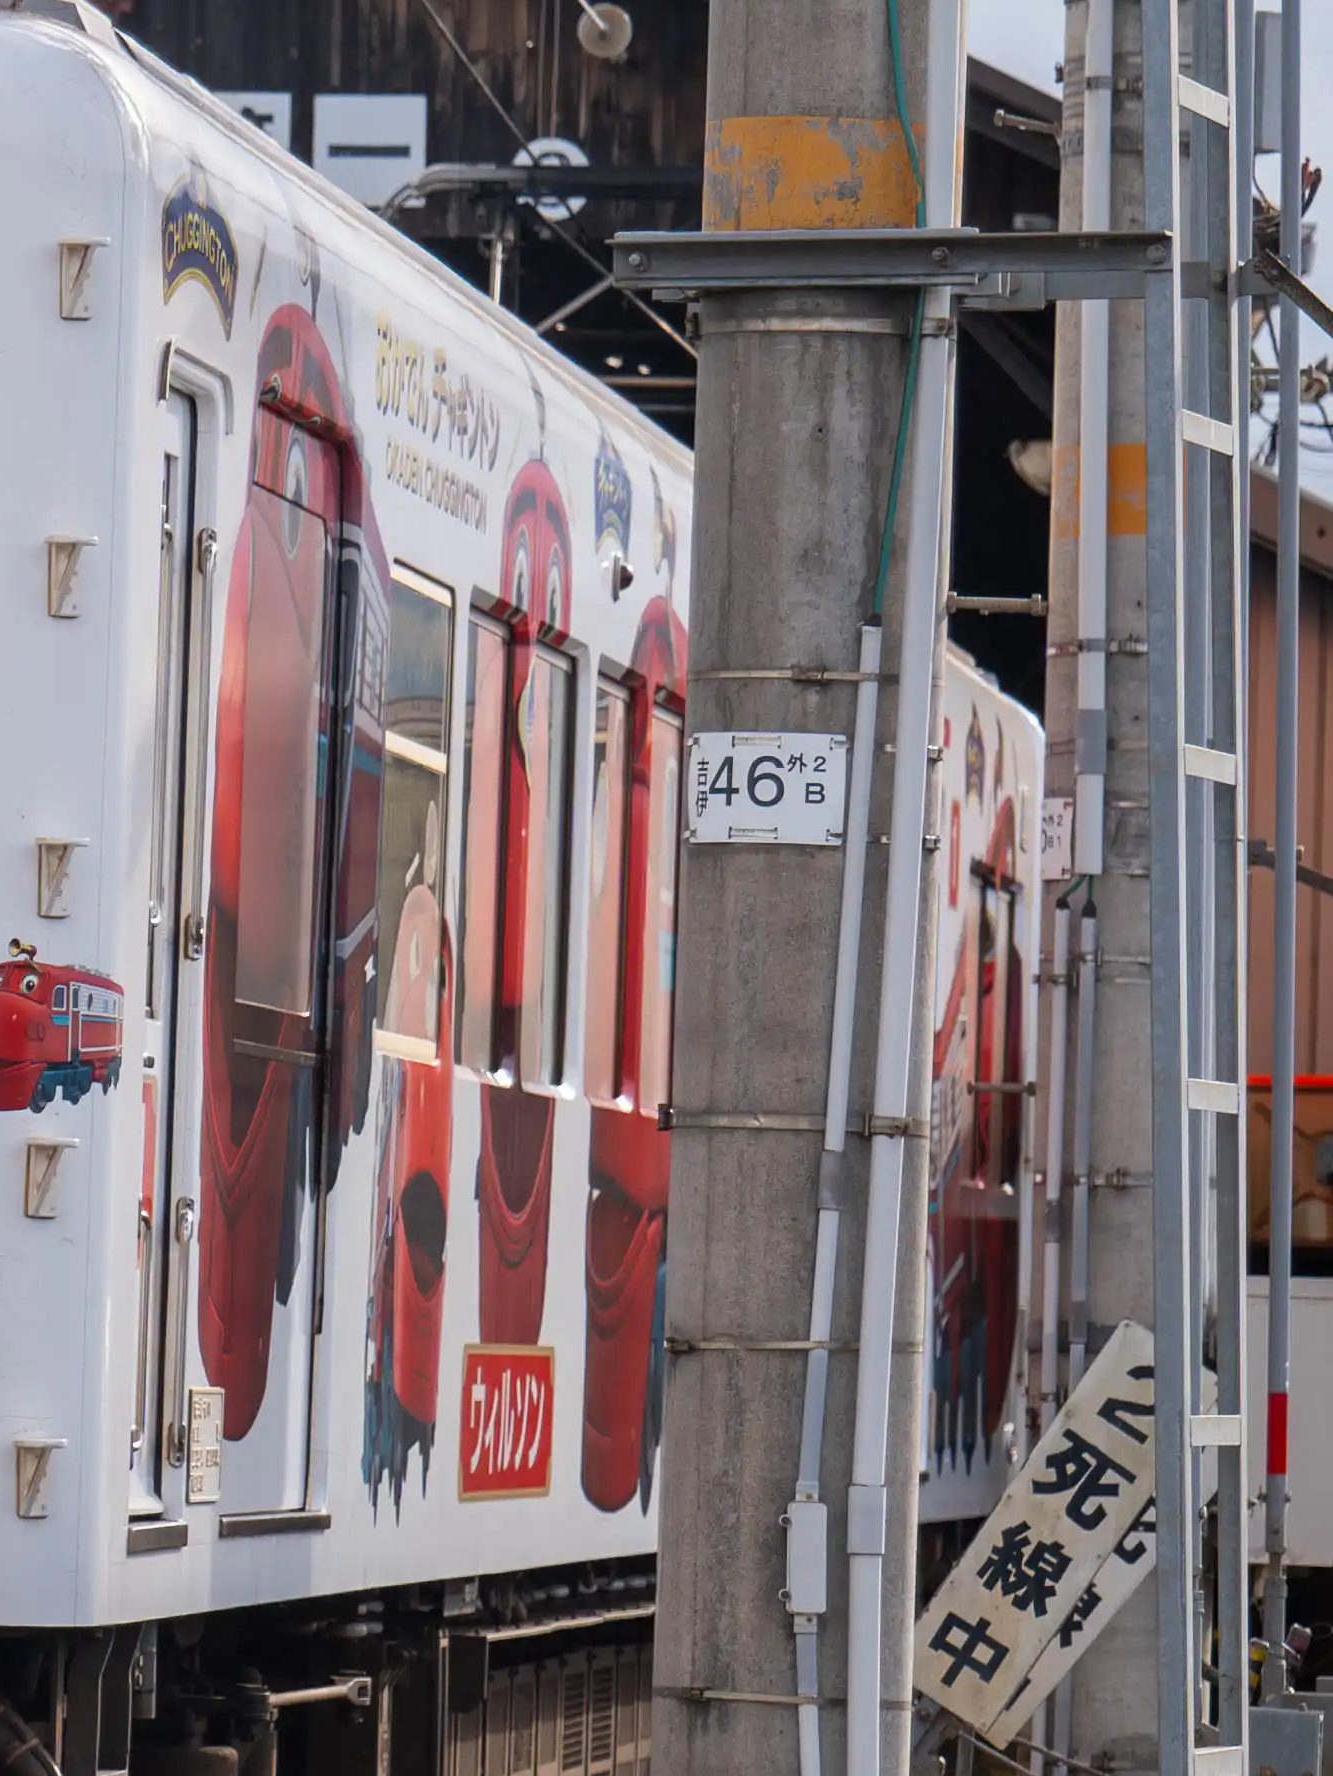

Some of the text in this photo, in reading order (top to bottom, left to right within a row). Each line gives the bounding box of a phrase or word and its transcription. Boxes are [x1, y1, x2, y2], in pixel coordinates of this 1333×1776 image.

[164, 212, 233, 307] CHUGGINGTON
[708, 755, 786, 808] 46
[804, 782, 826, 804] B
[470, 1366, 545, 1475] ウィルソン
